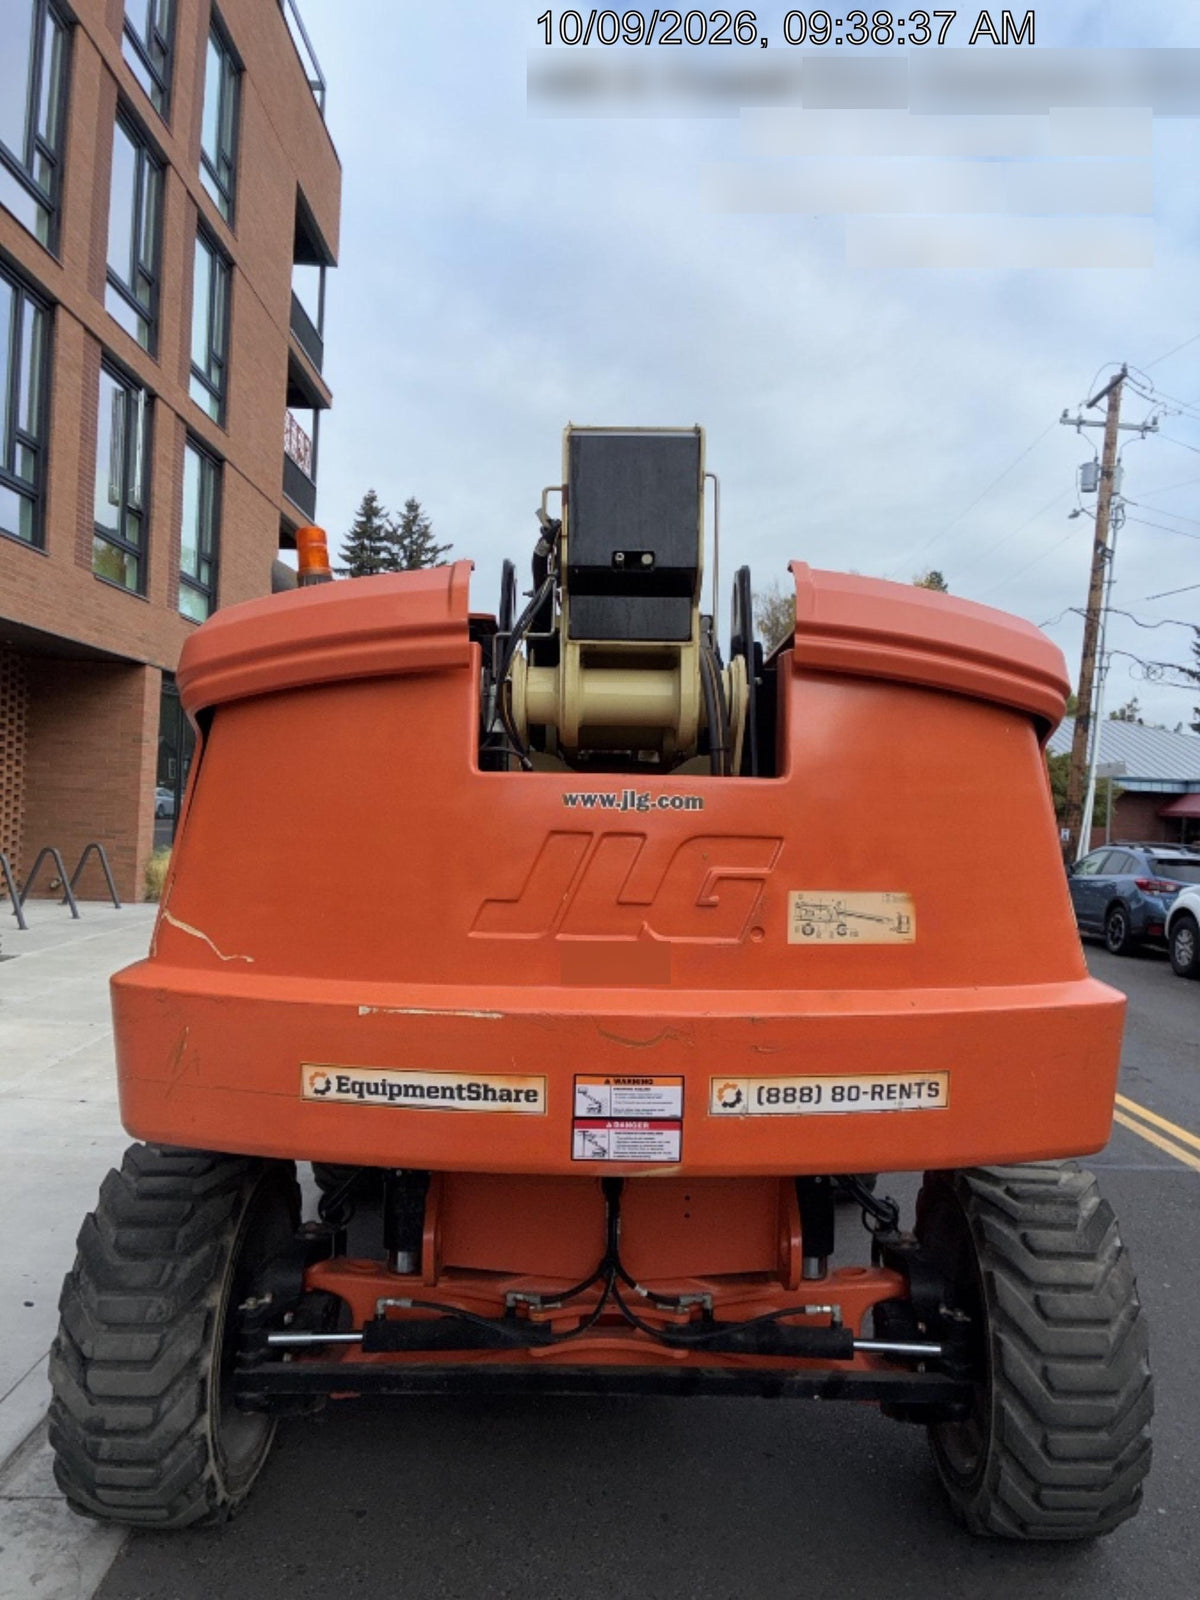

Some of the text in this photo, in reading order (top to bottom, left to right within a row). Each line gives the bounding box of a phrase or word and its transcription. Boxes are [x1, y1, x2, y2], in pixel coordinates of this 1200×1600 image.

[563, 789, 704, 812] www.jlg.com
[467, 830, 784, 946] JLG
[335, 1075, 538, 1104] EquipmentShare
[757, 1081, 940, 1105] (888) 80-RENTS
